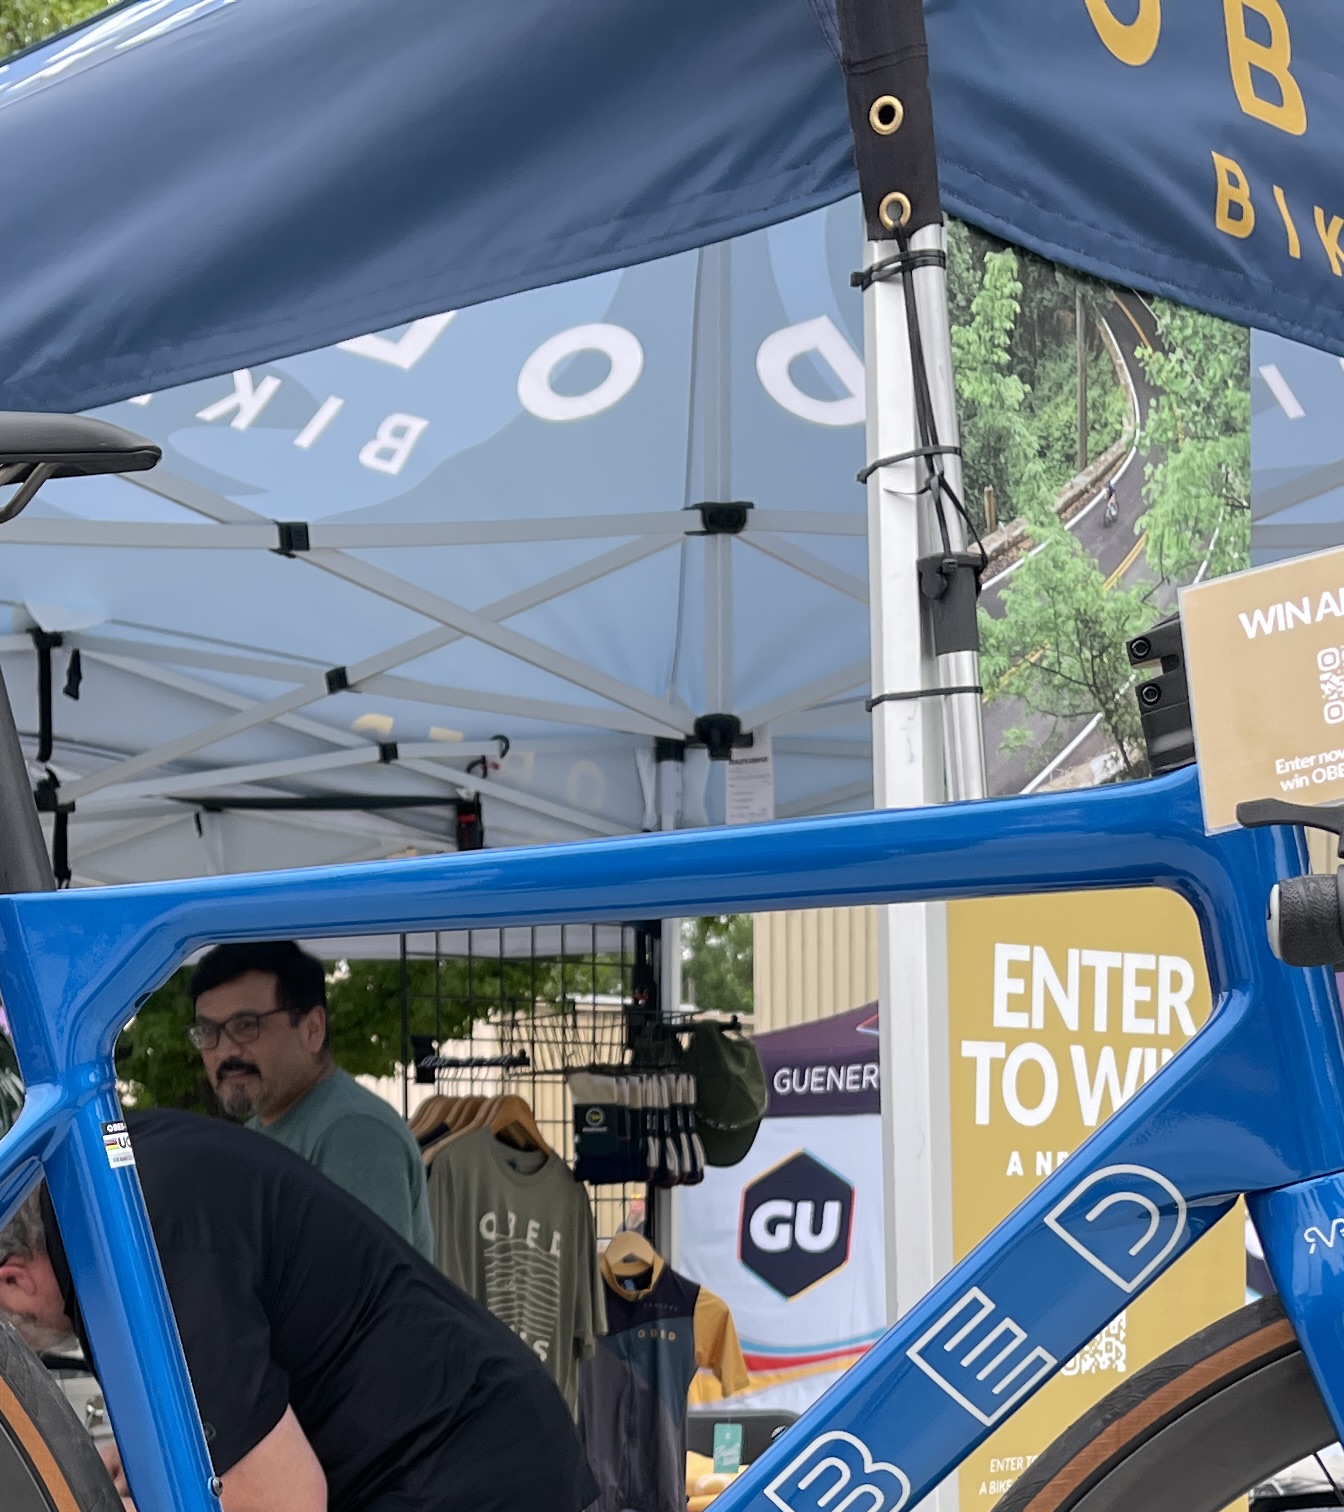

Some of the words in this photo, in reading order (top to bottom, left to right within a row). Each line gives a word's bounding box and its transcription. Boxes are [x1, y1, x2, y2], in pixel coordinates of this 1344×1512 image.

[1238, 595, 1312, 638] WIN
[1275, 751, 1317, 775] Enter
[1279, 769, 1311, 792] win
[993, 943, 1197, 1037] ENTER
[961, 1040, 1059, 1127] TO
[1006, 1151, 1025, 1176] A
[749, 1199, 842, 1252] GU
[989, 1457, 1024, 1473] ENTER
[978, 1481, 988, 1496] A
